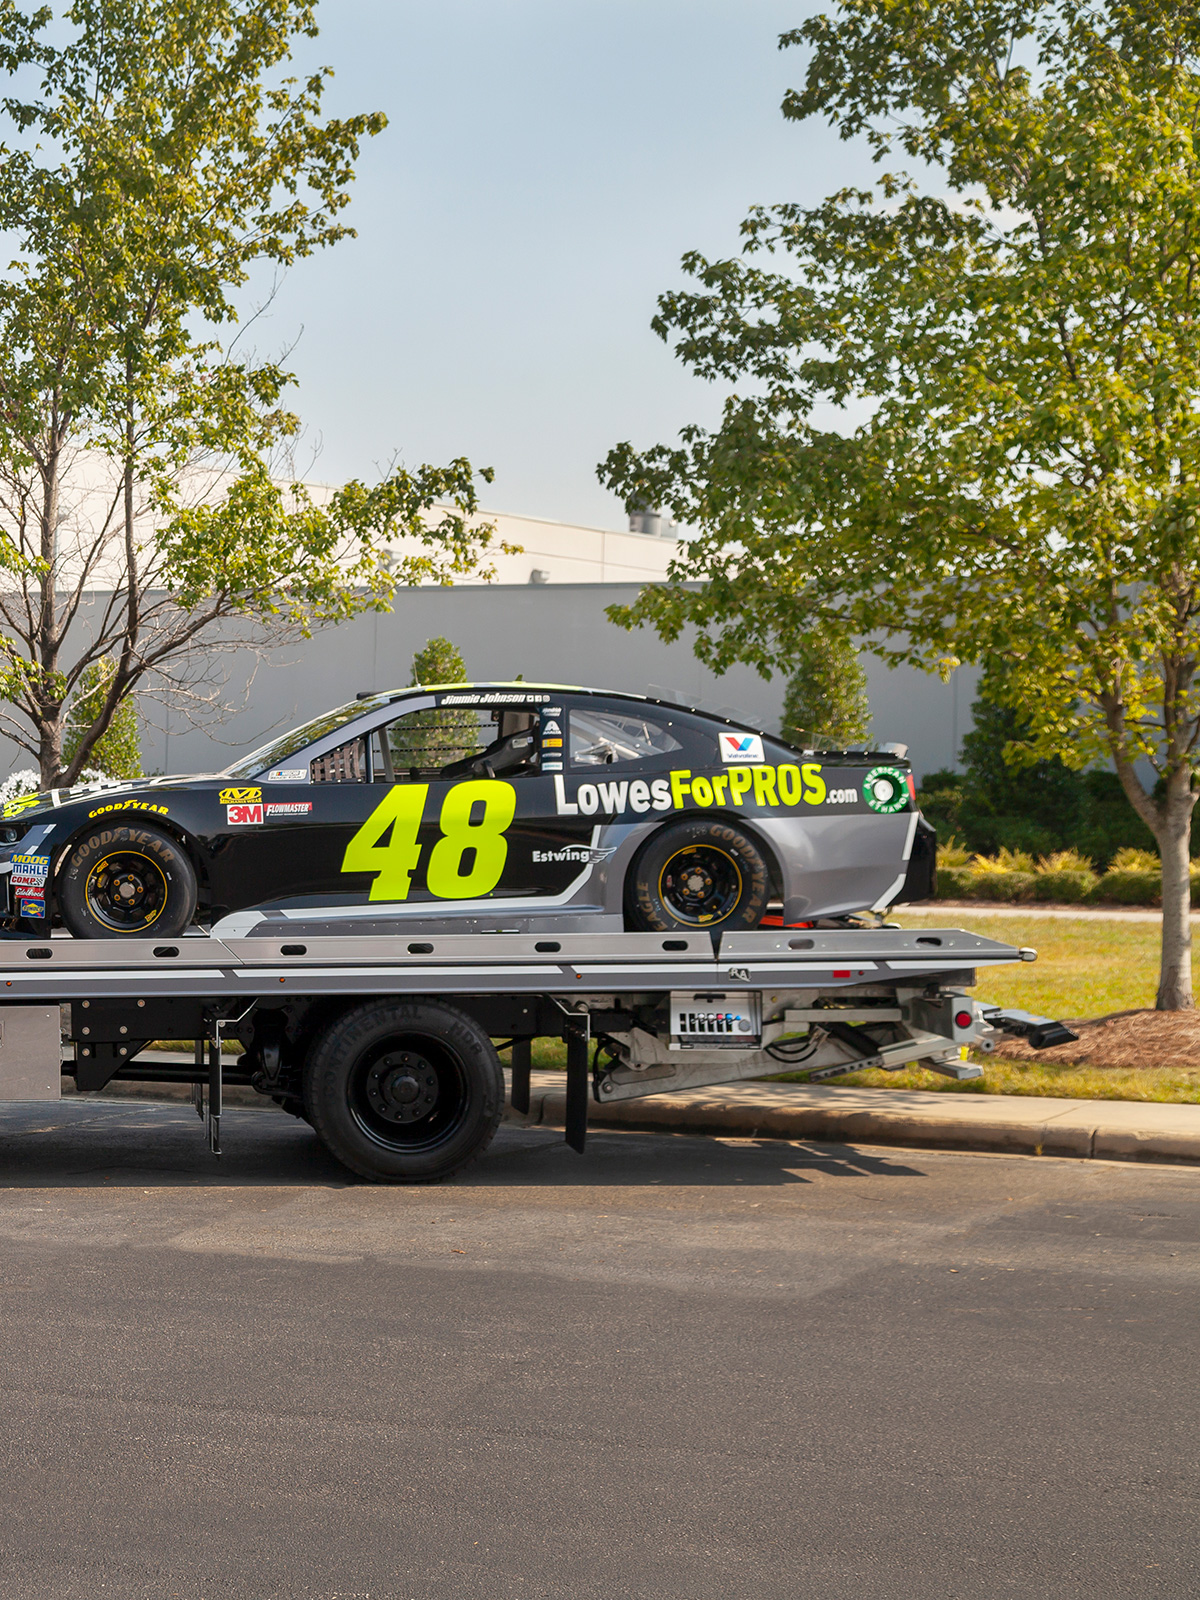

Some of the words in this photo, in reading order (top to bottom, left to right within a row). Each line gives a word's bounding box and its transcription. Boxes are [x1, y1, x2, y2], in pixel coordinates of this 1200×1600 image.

[441, 694, 481, 705] Jimmie
[480, 692, 526, 703] Johnson
[863, 766, 906, 790] AMERICAN
[554, 763, 858, 815] LowesForPROS.com
[88, 799, 170, 819] GOODYEAR
[266, 803, 310, 816] FLOWMASTER
[869, 793, 910, 813] ETHANOL
[228, 805, 262, 823] 3M
[71, 826, 176, 868] GOODYEAR
[340, 779, 517, 901] 48
[11, 854, 49, 865] MOOG
[532, 849, 591, 863] Estwing
[13, 864, 48, 875] MAHLE
[710, 824, 767, 923] GOODYEAR
[11, 876, 36, 884] COMP
[15, 888, 44, 898] Edelbrock
[637, 881, 668, 932] EAGLE
